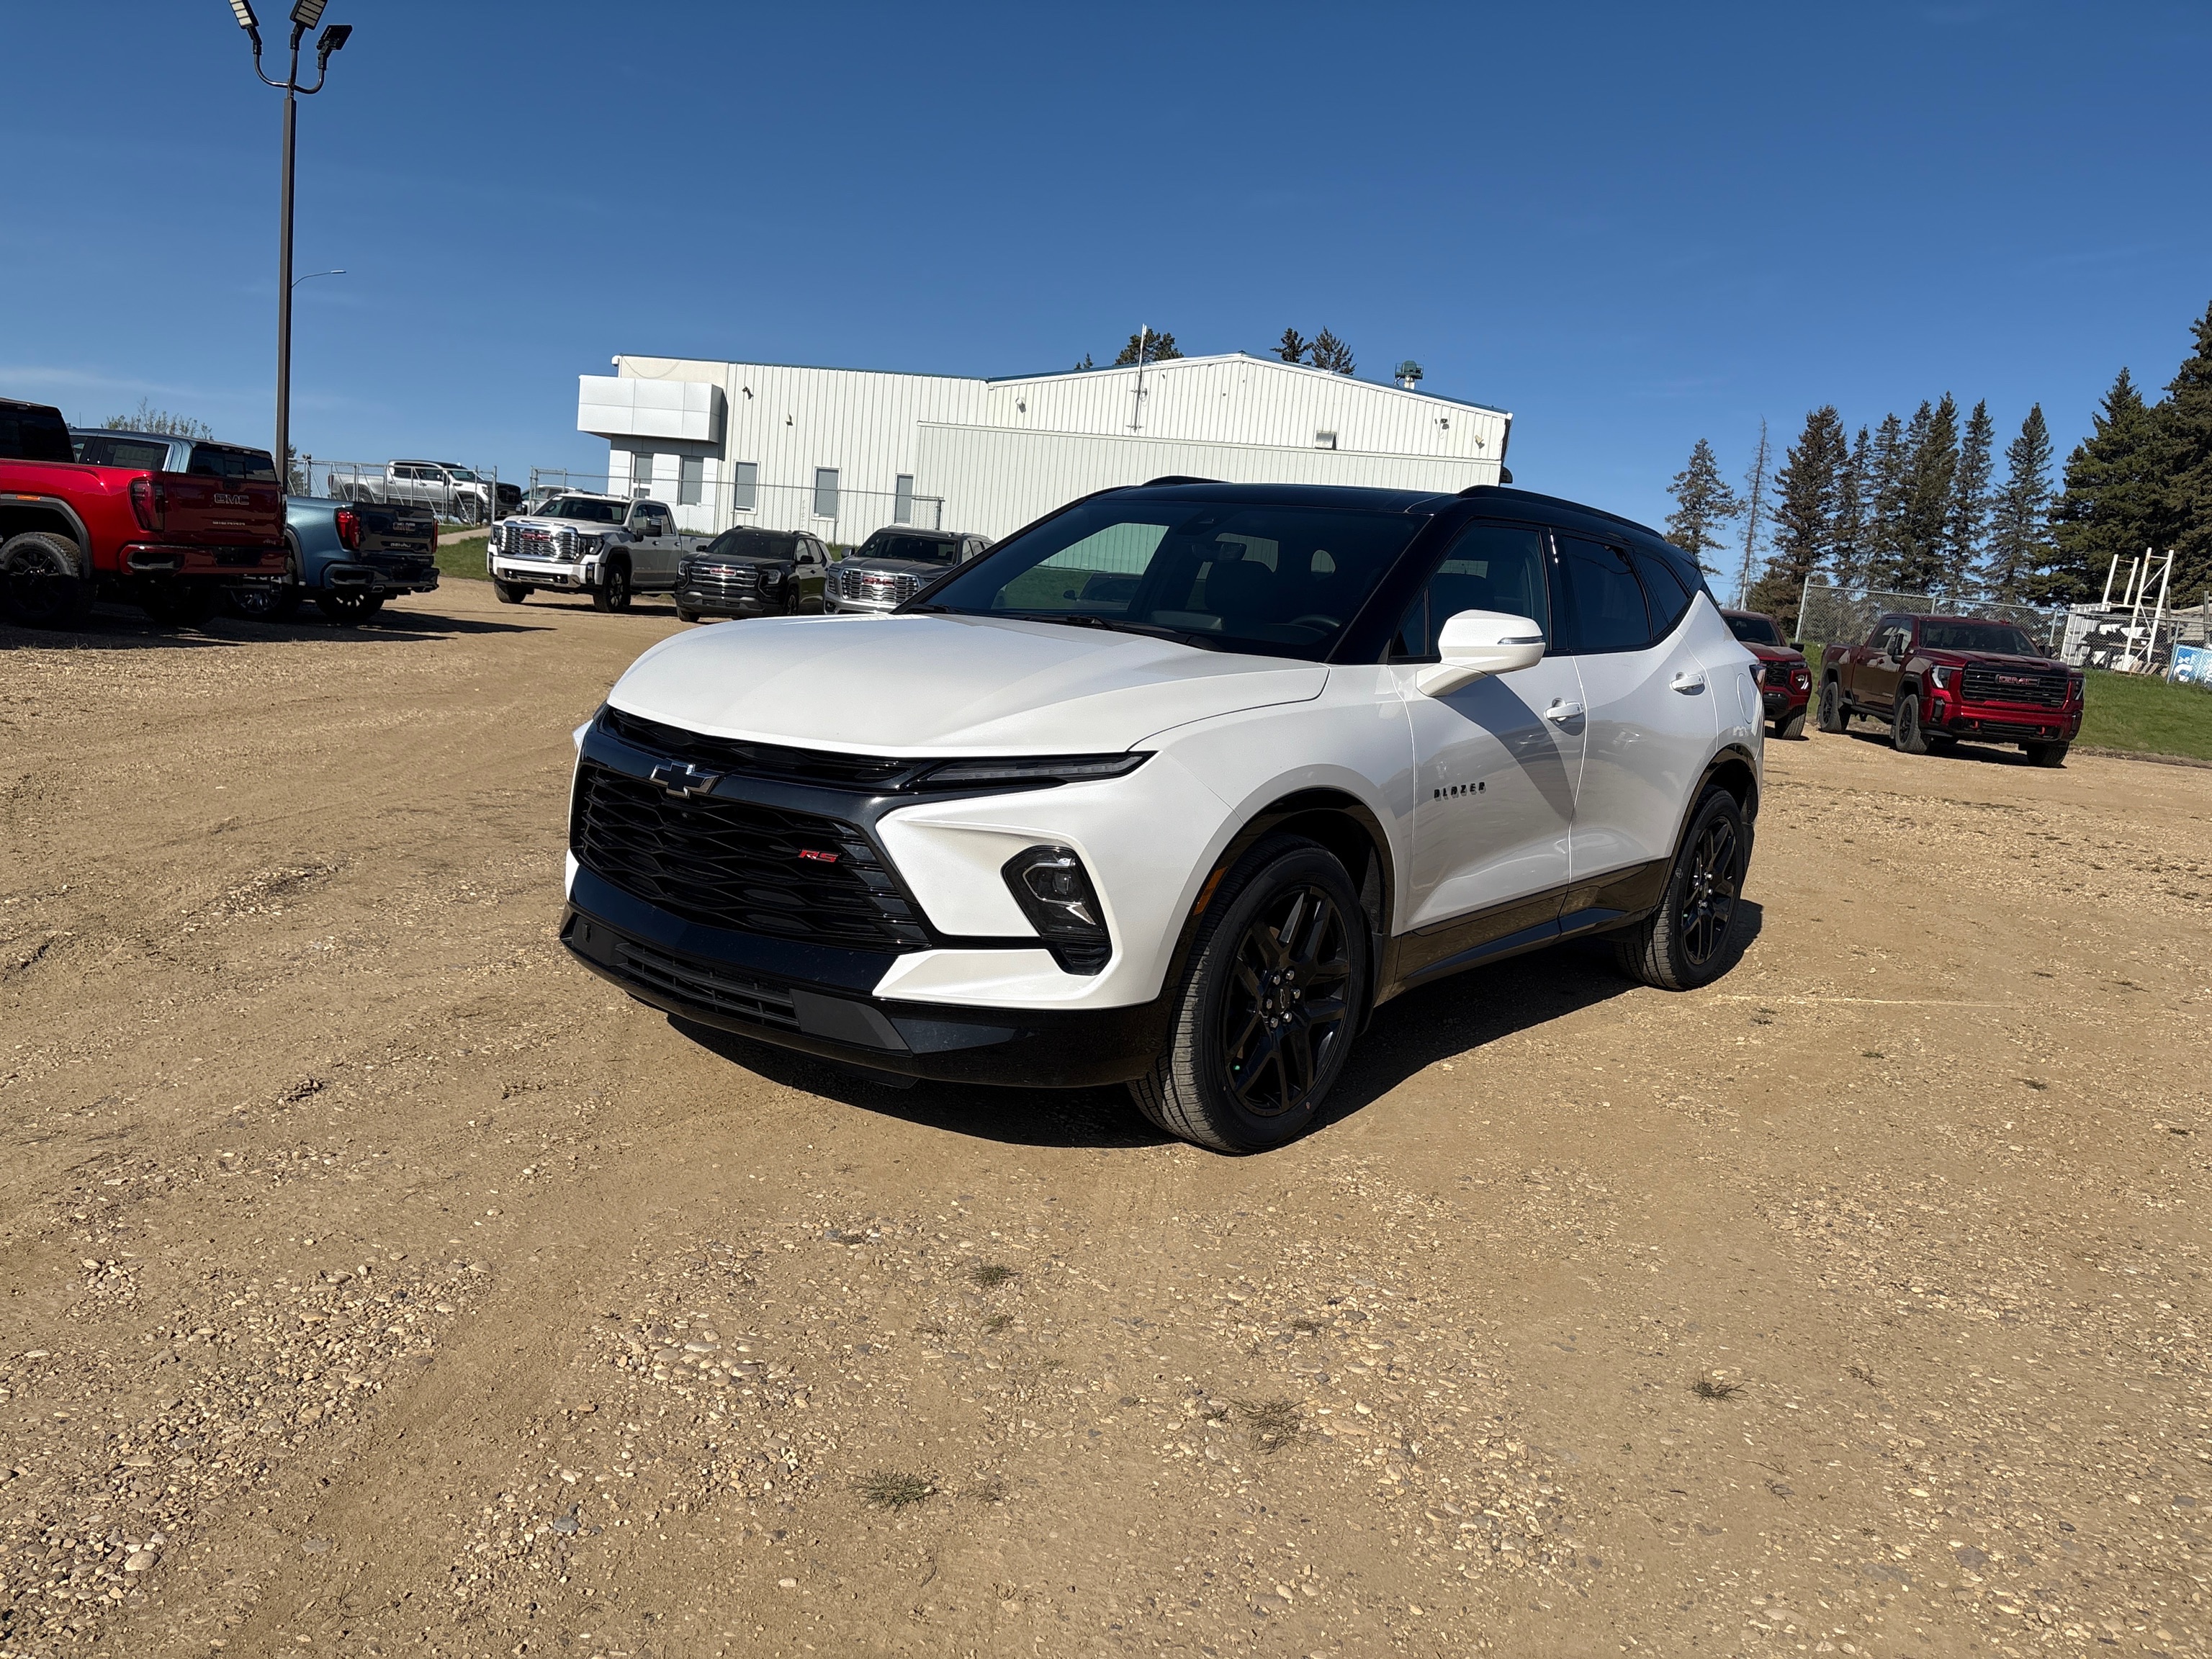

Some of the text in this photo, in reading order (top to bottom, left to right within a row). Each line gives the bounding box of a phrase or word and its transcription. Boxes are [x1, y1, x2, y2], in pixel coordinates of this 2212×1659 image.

[214, 493, 249, 505] GMC
[522, 533, 550, 541] GMC
[1998, 675, 2038, 685] GMC
[1434, 781, 1485, 799] BLAZER
[798, 850, 839, 863] RS
